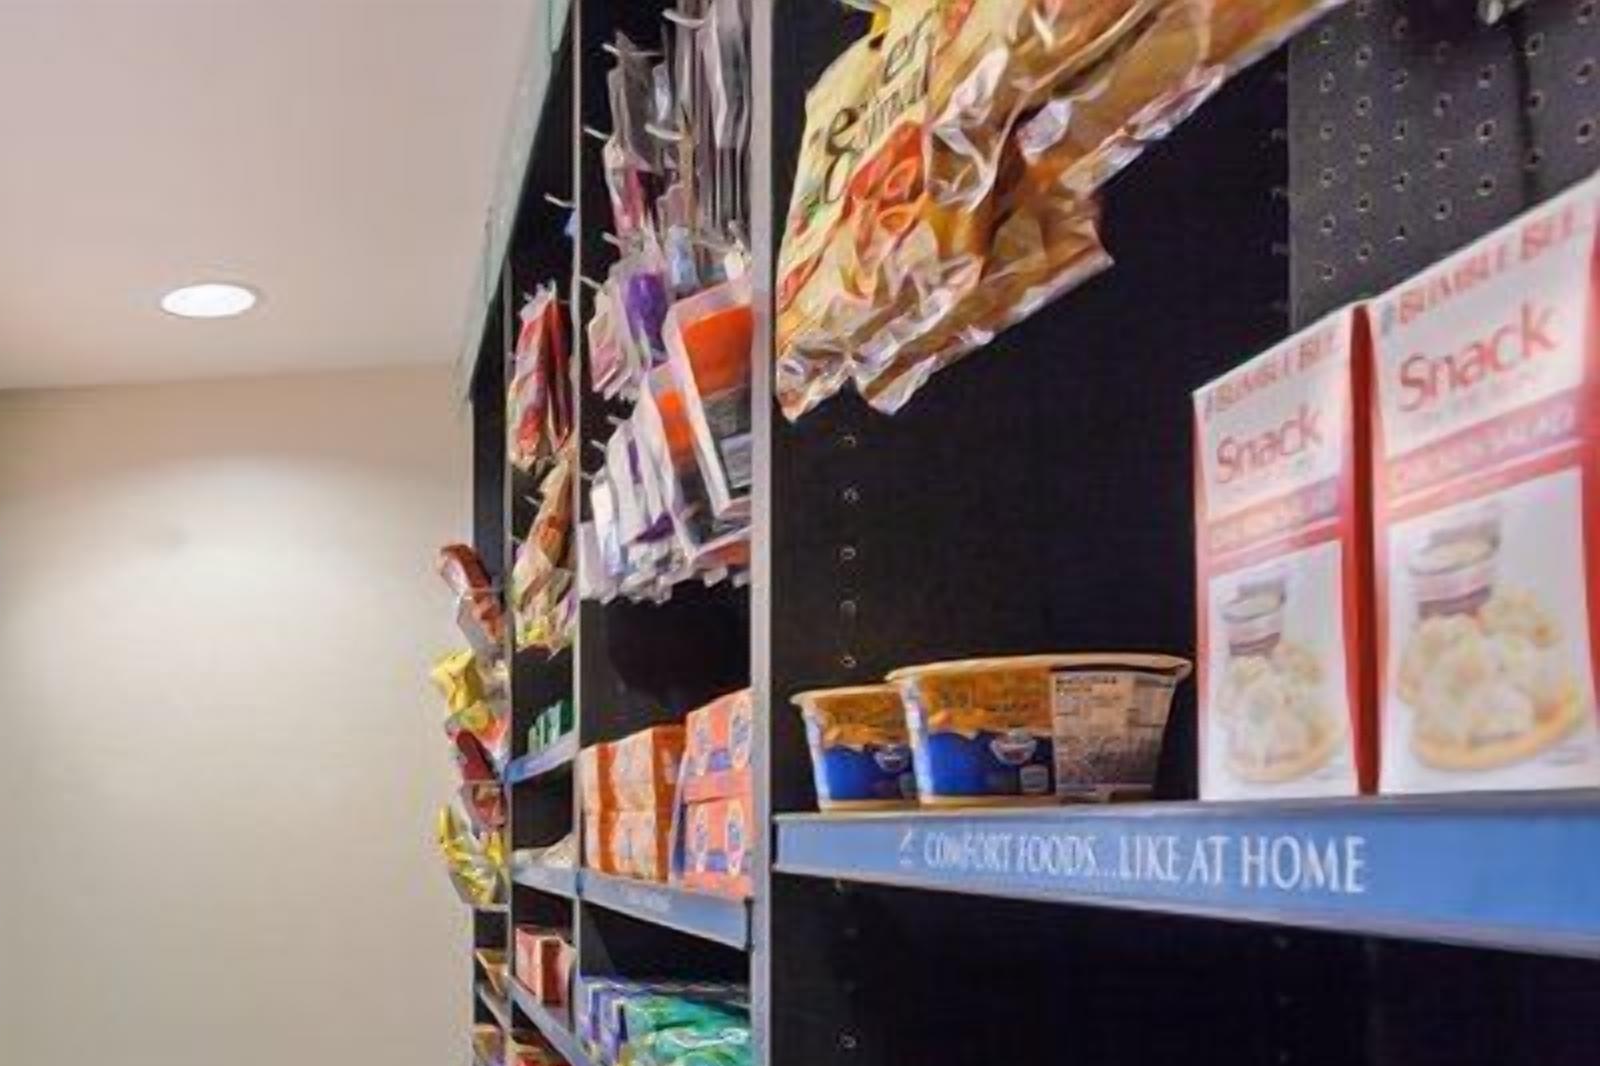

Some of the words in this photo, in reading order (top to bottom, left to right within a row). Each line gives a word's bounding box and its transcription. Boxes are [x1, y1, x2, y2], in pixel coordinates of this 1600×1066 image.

[1398, 302, 1558, 412] Snack
[1216, 405, 1323, 484] Snack
[1119, 836, 1181, 882] LIKE
[1186, 836, 1231, 885] AT
[1240, 835, 1367, 894] HOME
